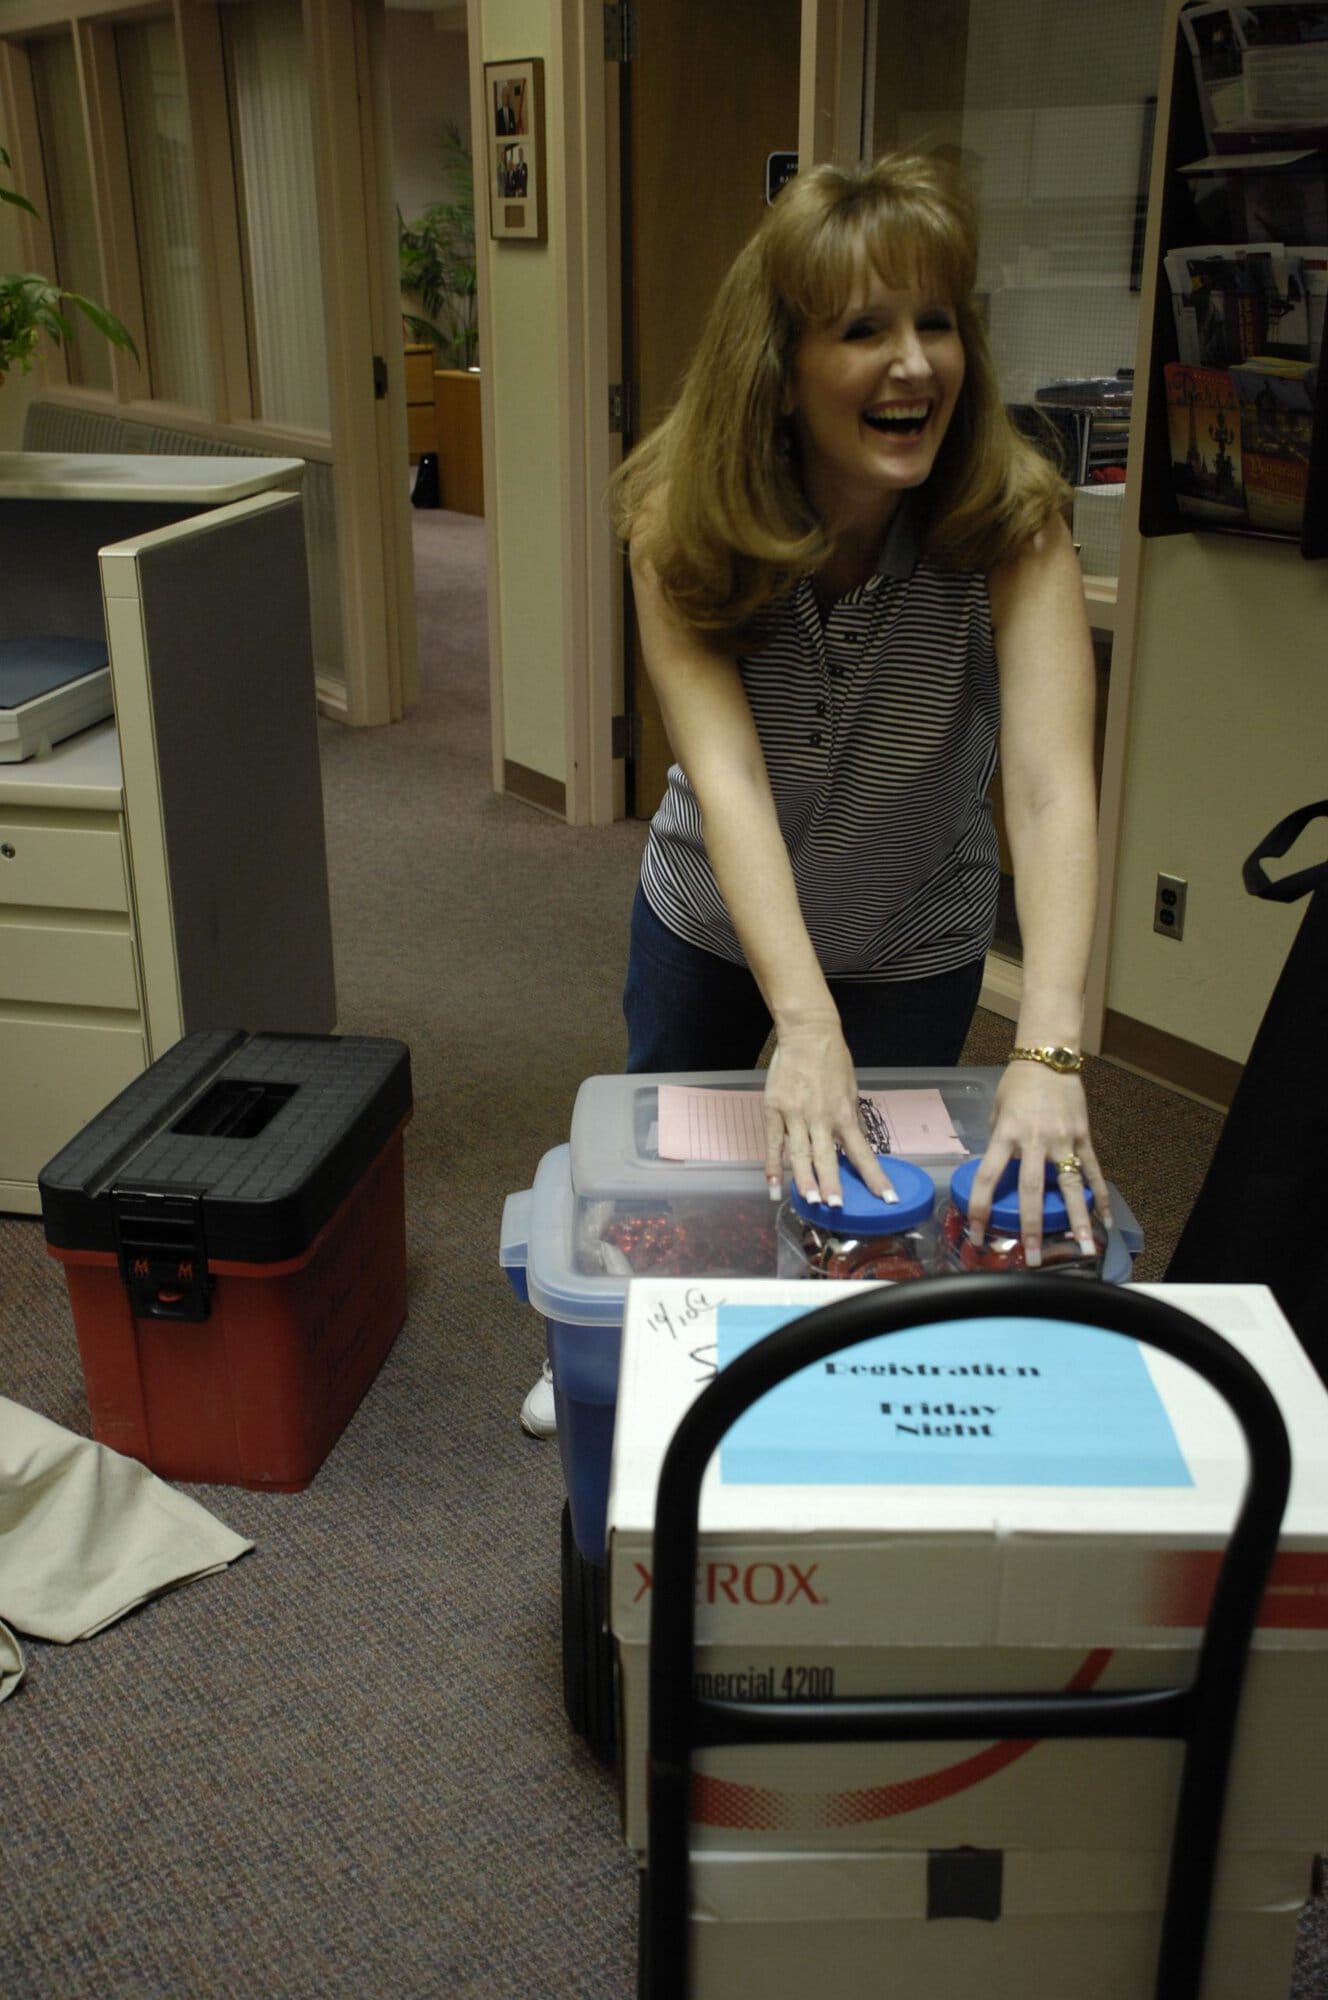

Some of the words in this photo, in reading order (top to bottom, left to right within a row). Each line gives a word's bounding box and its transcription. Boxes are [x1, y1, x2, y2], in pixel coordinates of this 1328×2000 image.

[824, 1361, 1042, 1378] Registration
[879, 1401, 1001, 1418] Friday
[895, 1422, 994, 1438] Night
[632, 1561, 824, 1606] XROX
[694, 1666, 775, 1699] mercial
[781, 1666, 834, 1699] 4200
